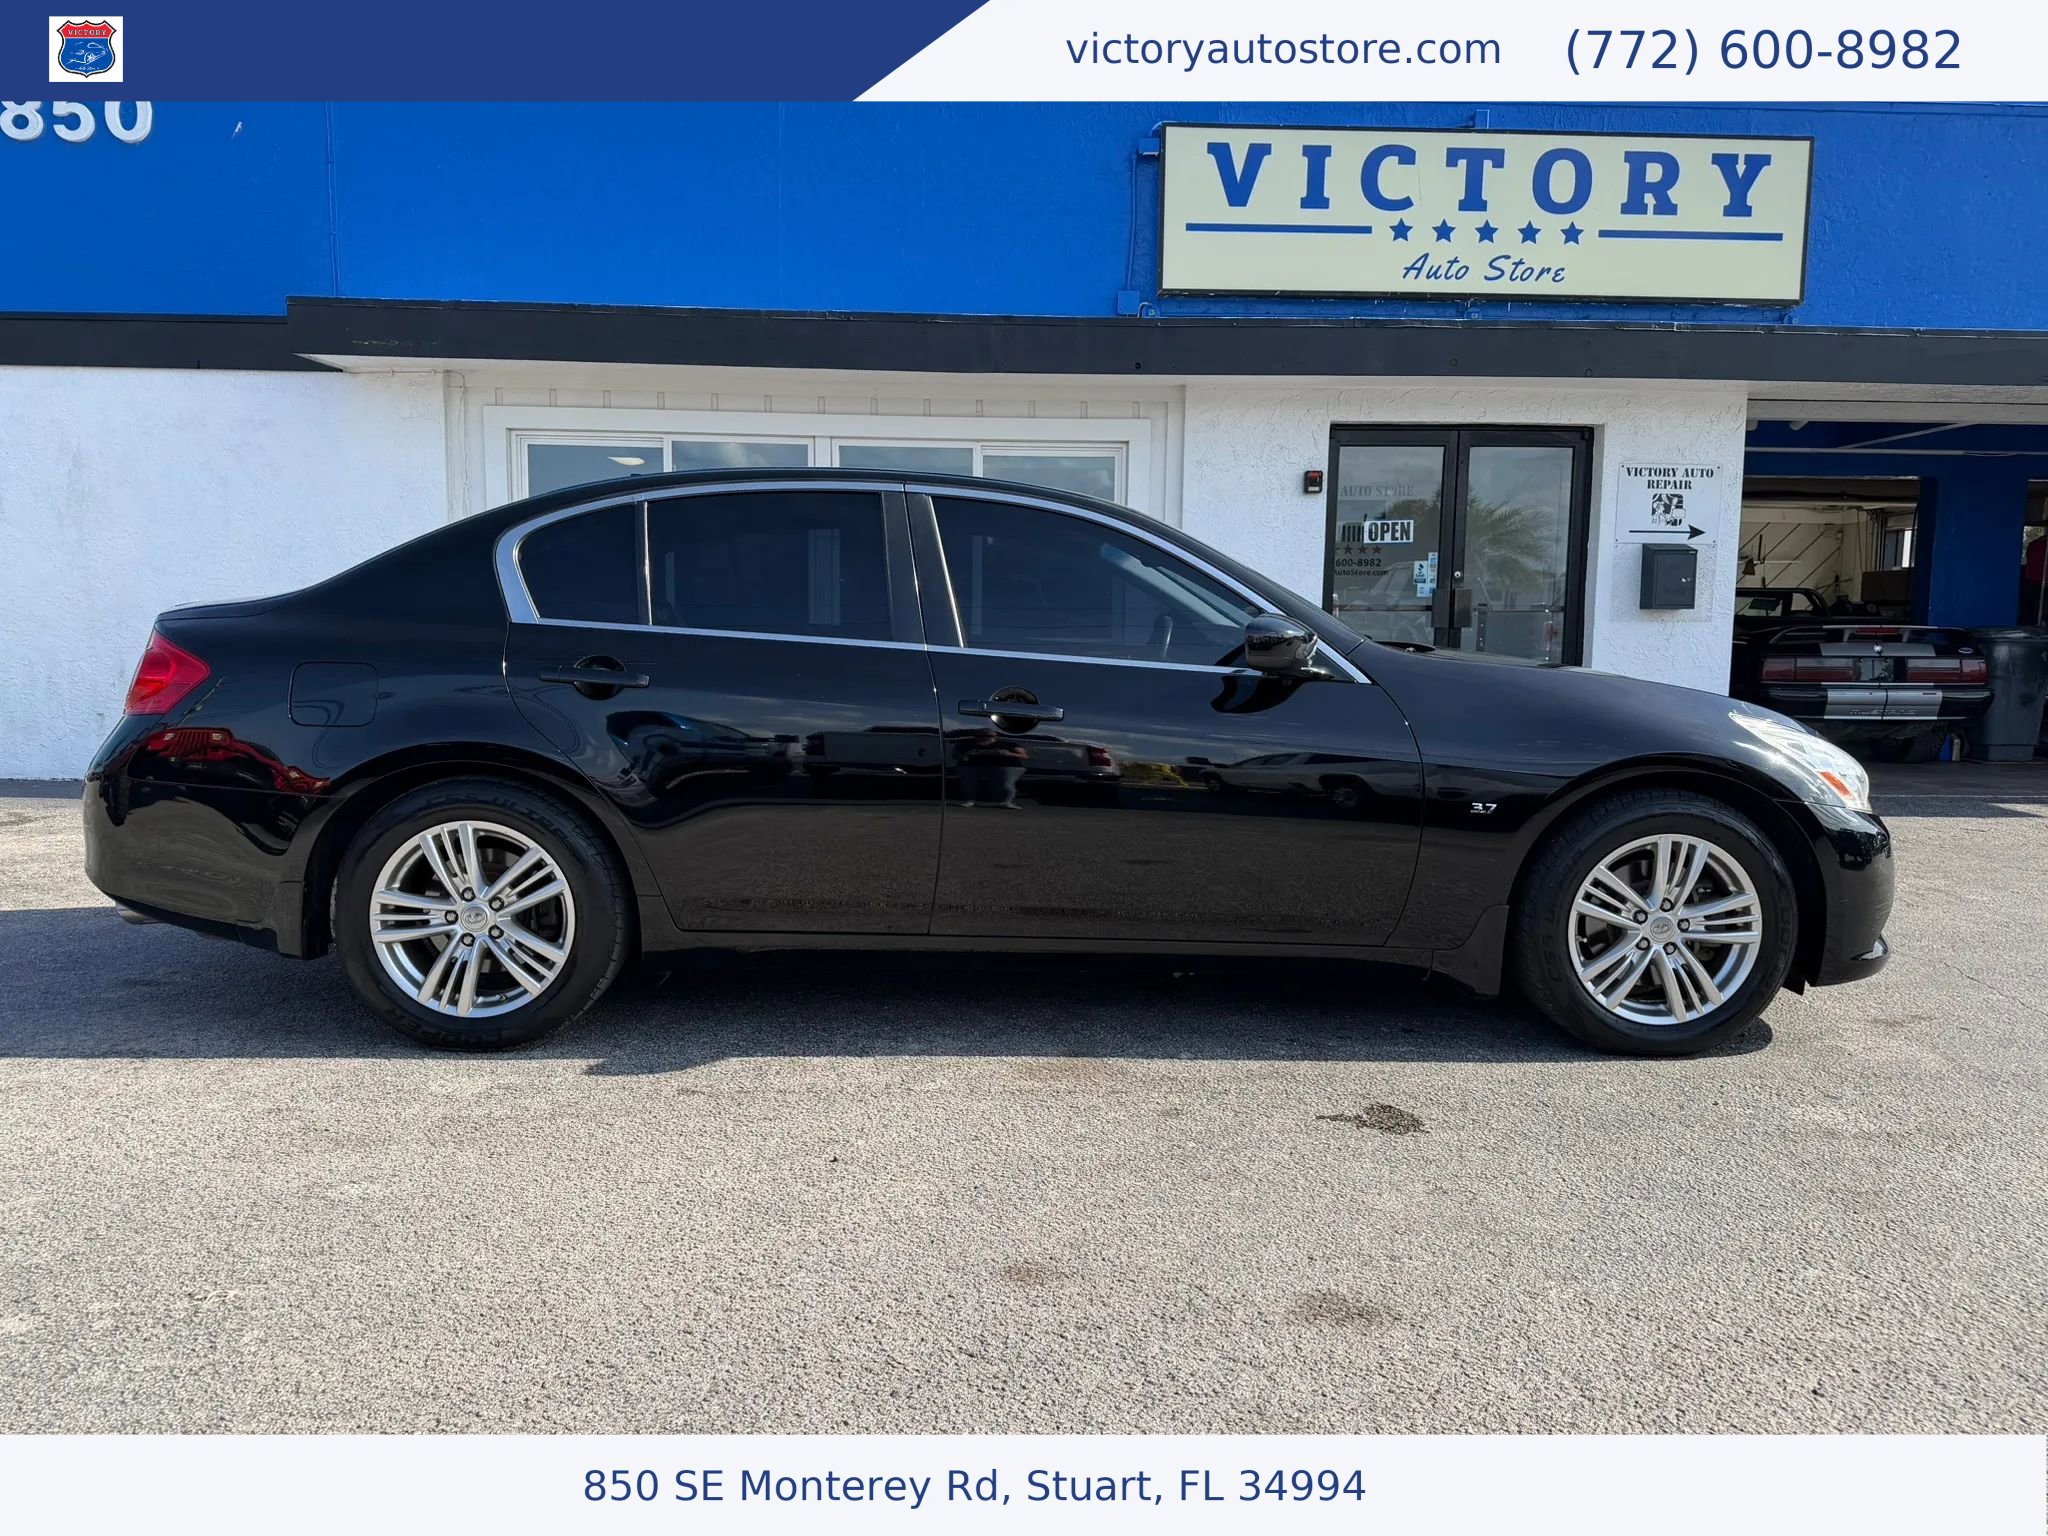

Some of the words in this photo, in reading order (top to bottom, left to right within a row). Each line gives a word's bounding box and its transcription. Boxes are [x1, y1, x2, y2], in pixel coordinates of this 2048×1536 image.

[1206, 142, 1772, 218] VICTORY
[1403, 252, 1470, 282] Auto
[1485, 253, 1566, 284] Store
[1626, 466, 1679, 478] VICTORY
[1682, 468, 1715, 479] AUTO
[1647, 479, 1693, 490] REPAIR
[1368, 521, 1411, 542] OPEN
